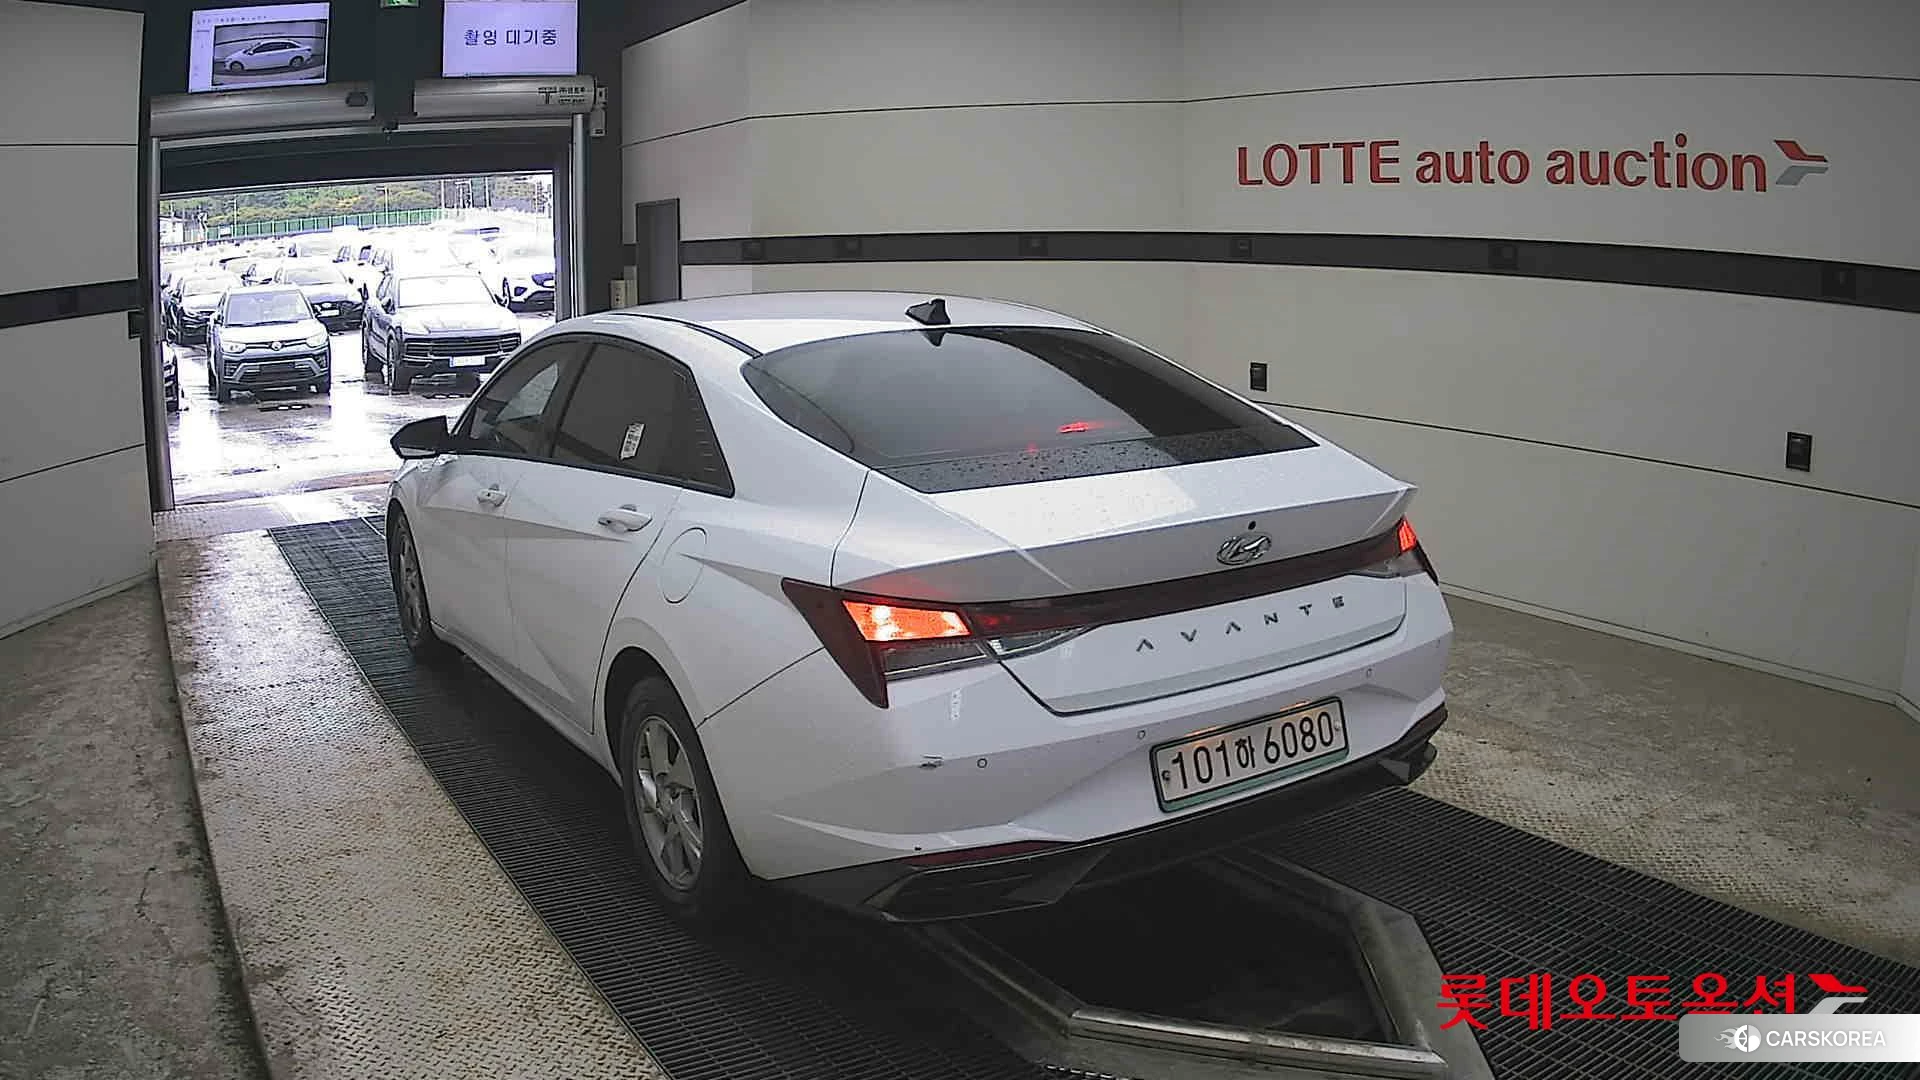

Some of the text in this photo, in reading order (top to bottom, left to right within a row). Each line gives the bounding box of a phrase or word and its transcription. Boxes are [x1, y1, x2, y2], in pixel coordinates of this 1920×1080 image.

[464, 29, 557, 46] 촬영 대기중
[1237, 132, 1767, 193] LOTTE auto auction
[1136, 595, 1345, 652] AVANTE
